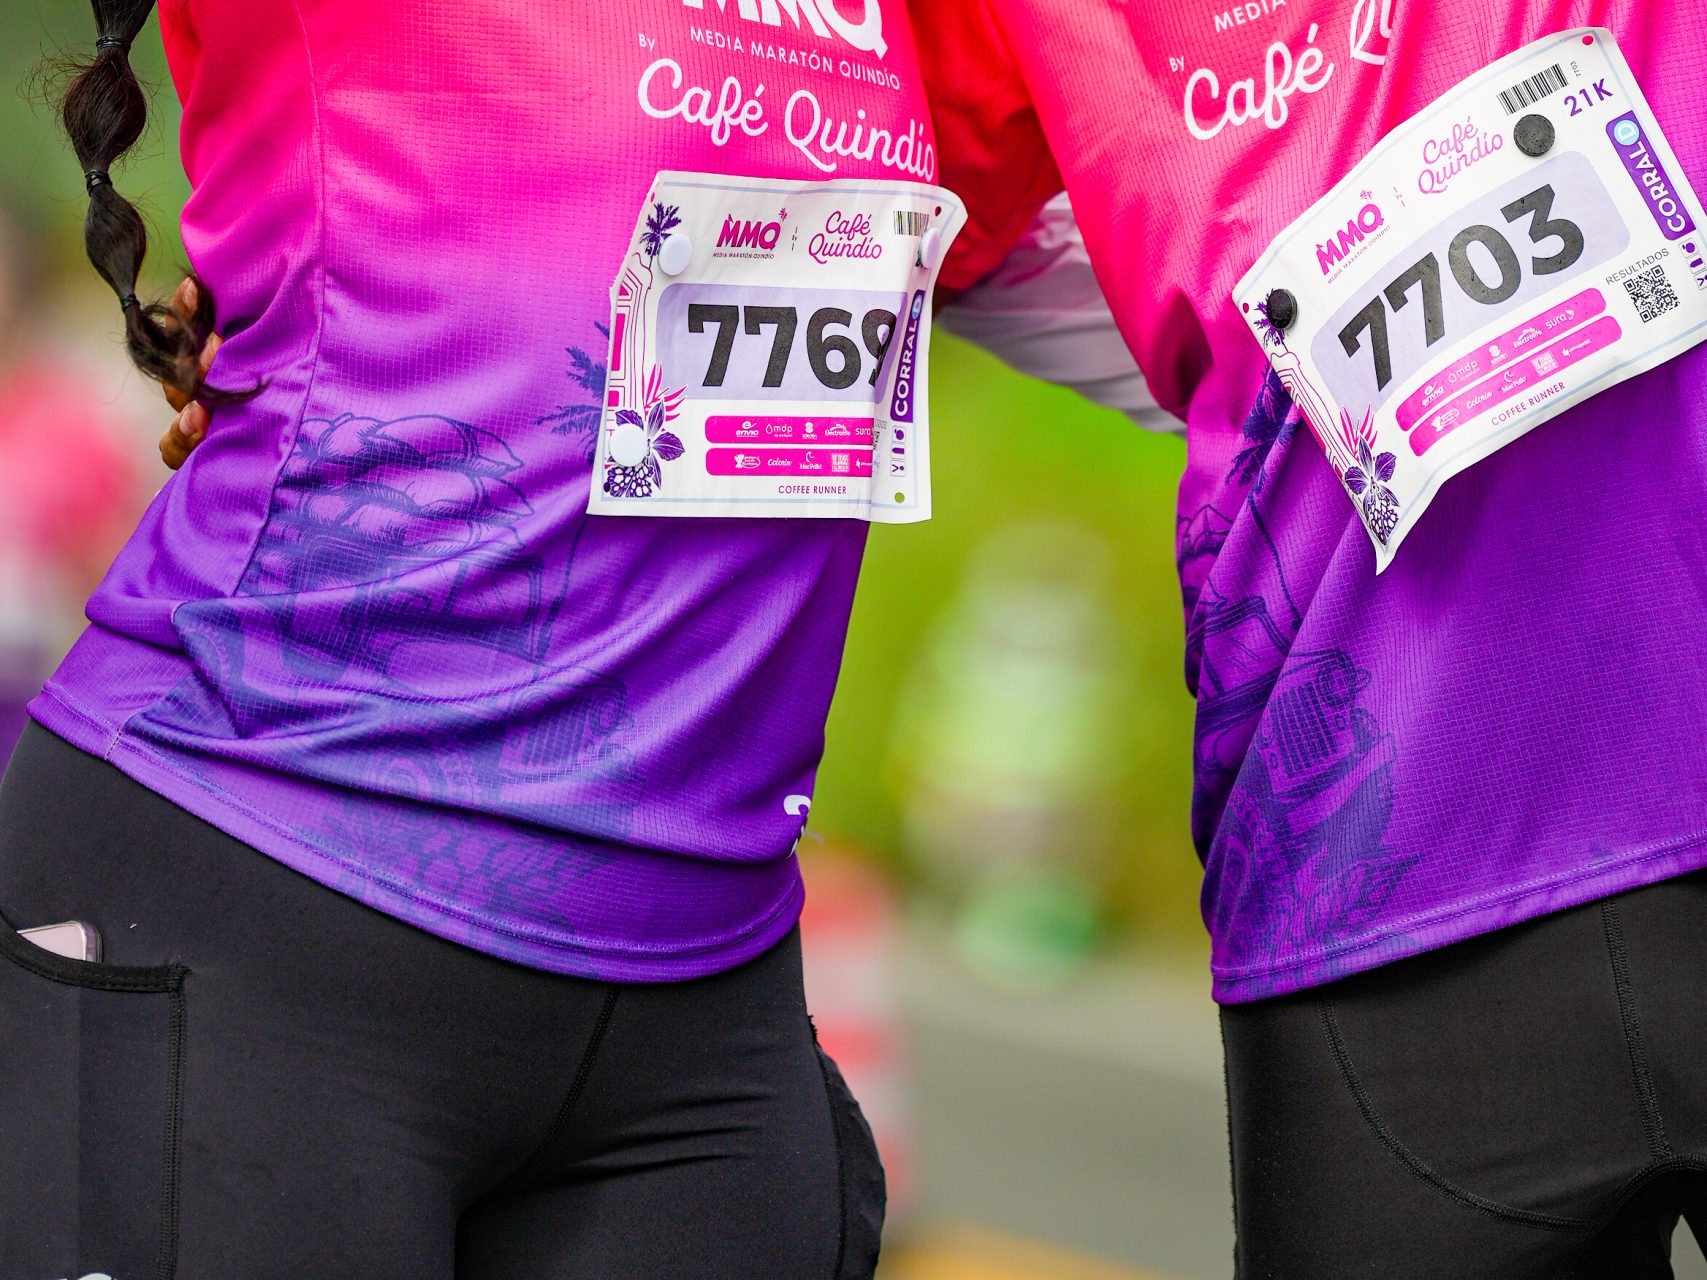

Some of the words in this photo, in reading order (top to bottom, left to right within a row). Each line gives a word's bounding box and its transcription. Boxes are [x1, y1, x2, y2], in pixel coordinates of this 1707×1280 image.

[690, 26, 744, 53] MEDIA
[751, 42, 833, 73] MARATÓN
[839, 61, 901, 90] QUINDÍO
[1183, 23, 1335, 141] Café
[637, 58, 768, 147] Café
[784, 89, 935, 183] Quindío
[1564, 78, 1613, 117] 21K
[1423, 116, 1478, 164] Café
[1617, 123, 1637, 141] D
[1418, 132, 1504, 194] Quindío
[1628, 140, 1686, 233] CORRAL
[716, 219, 781, 251] MMQ
[808, 233, 882, 264] Quindío
[825, 210, 872, 240] Café
[1316, 203, 1384, 276] MMQ
[1337, 183, 1585, 392] 7703
[1605, 248, 1670, 286] RESULTADOS
[688, 303, 897, 389] 7769
[894, 320, 918, 417] CORRAL
[1491, 402, 1527, 426] COFFEE
[1528, 381, 1566, 406] RUNNER
[773, 423, 793, 434] mdp
[778, 485, 810, 494] COFFEE
[813, 485, 847, 495] RUNNER
